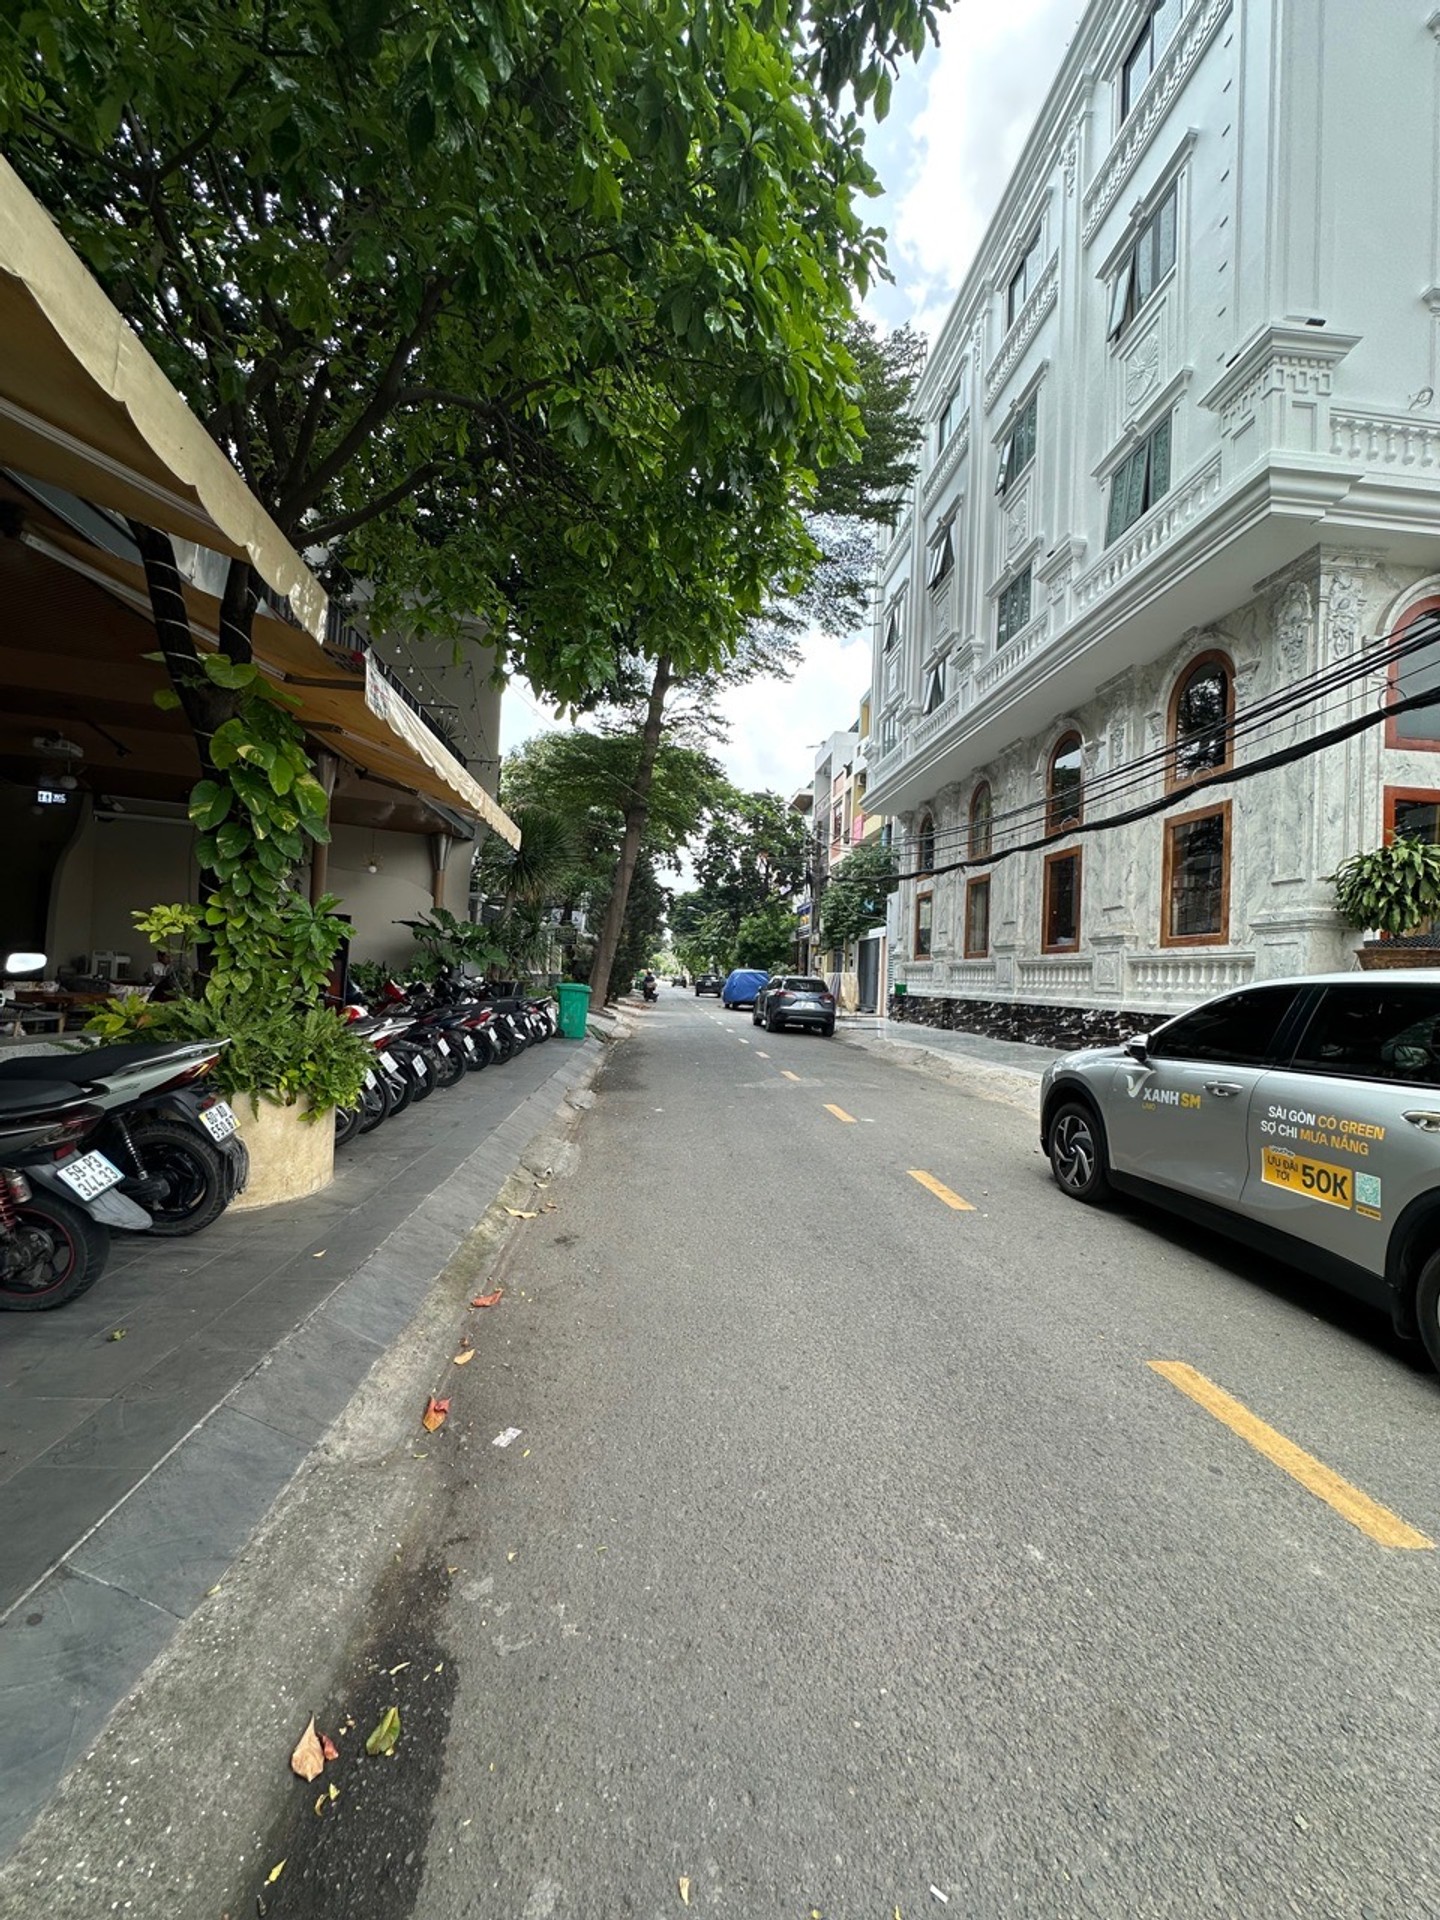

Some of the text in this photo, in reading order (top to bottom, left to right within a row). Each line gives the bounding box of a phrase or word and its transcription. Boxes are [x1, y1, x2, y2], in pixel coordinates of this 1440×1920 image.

[1143, 1088, 1201, 1109] XANH SM
[1260, 1120, 1276, 1135] SỢ
[1278, 1124, 1298, 1139] CHI
[1300, 1128, 1329, 1146] MƯA
[1268, 1105, 1386, 1140] SÀI GÒN CÓ GREEN
[65, 1155, 103, 1182] 59-P3
[77, 1167, 119, 1198] 344.33
[1301, 1164, 1348, 1200] 50K
